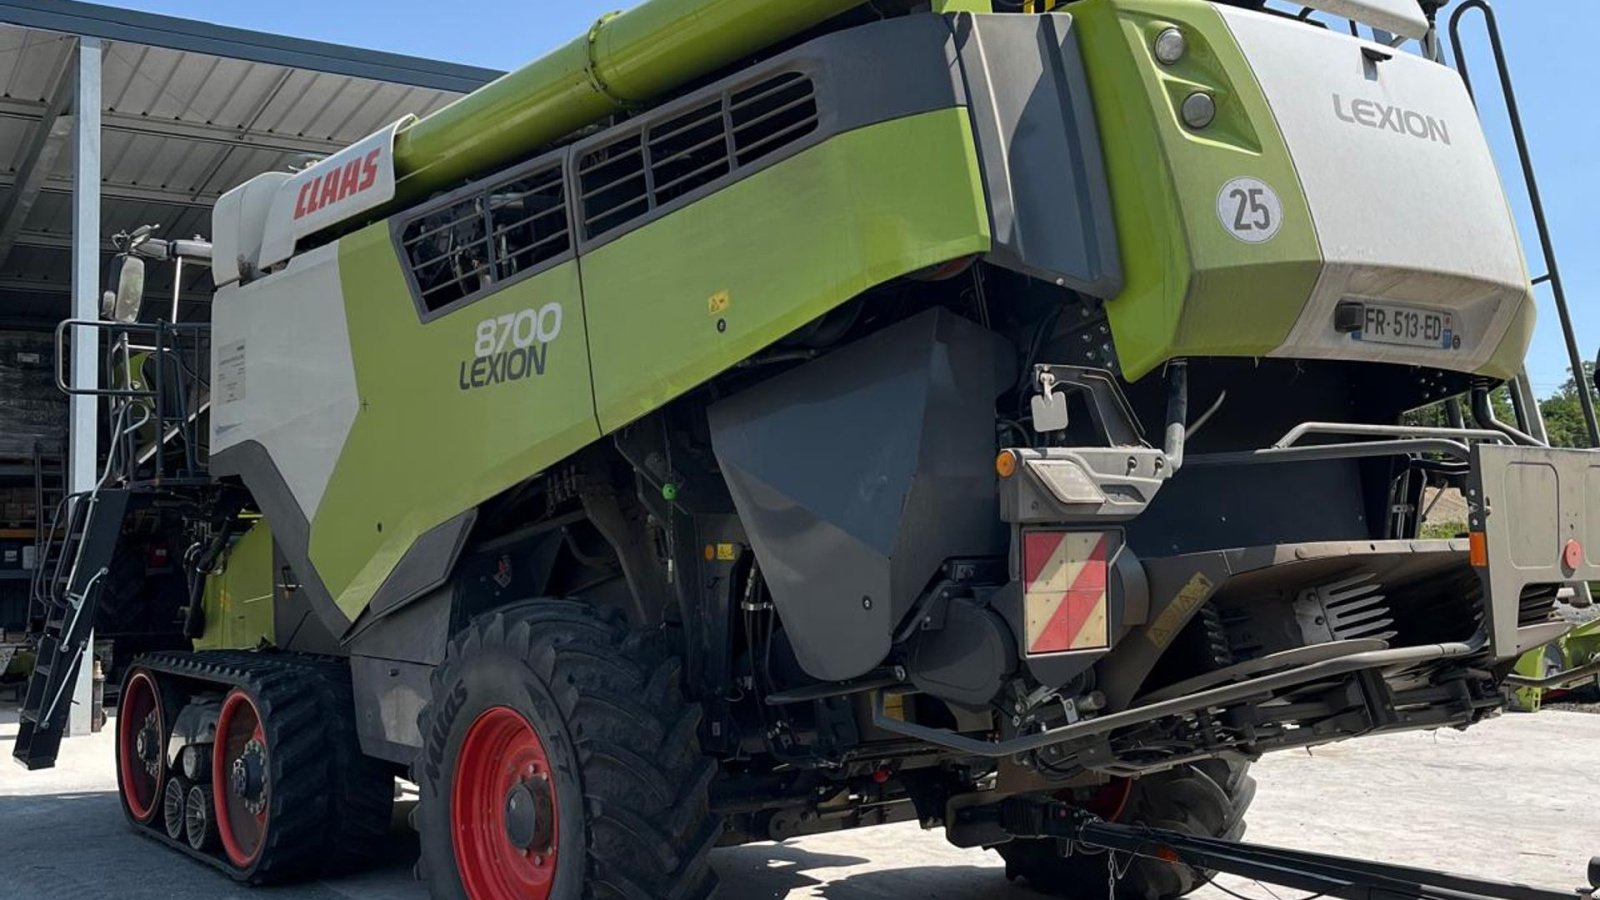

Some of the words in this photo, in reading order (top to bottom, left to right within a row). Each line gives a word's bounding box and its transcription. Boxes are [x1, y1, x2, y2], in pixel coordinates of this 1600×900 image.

[1333, 94, 1451, 146] LEXION
[293, 146, 382, 220] CLAAS
[1229, 188, 1271, 231] 25
[475, 302, 562, 358] 8700
[459, 342, 547, 390] LEXION
